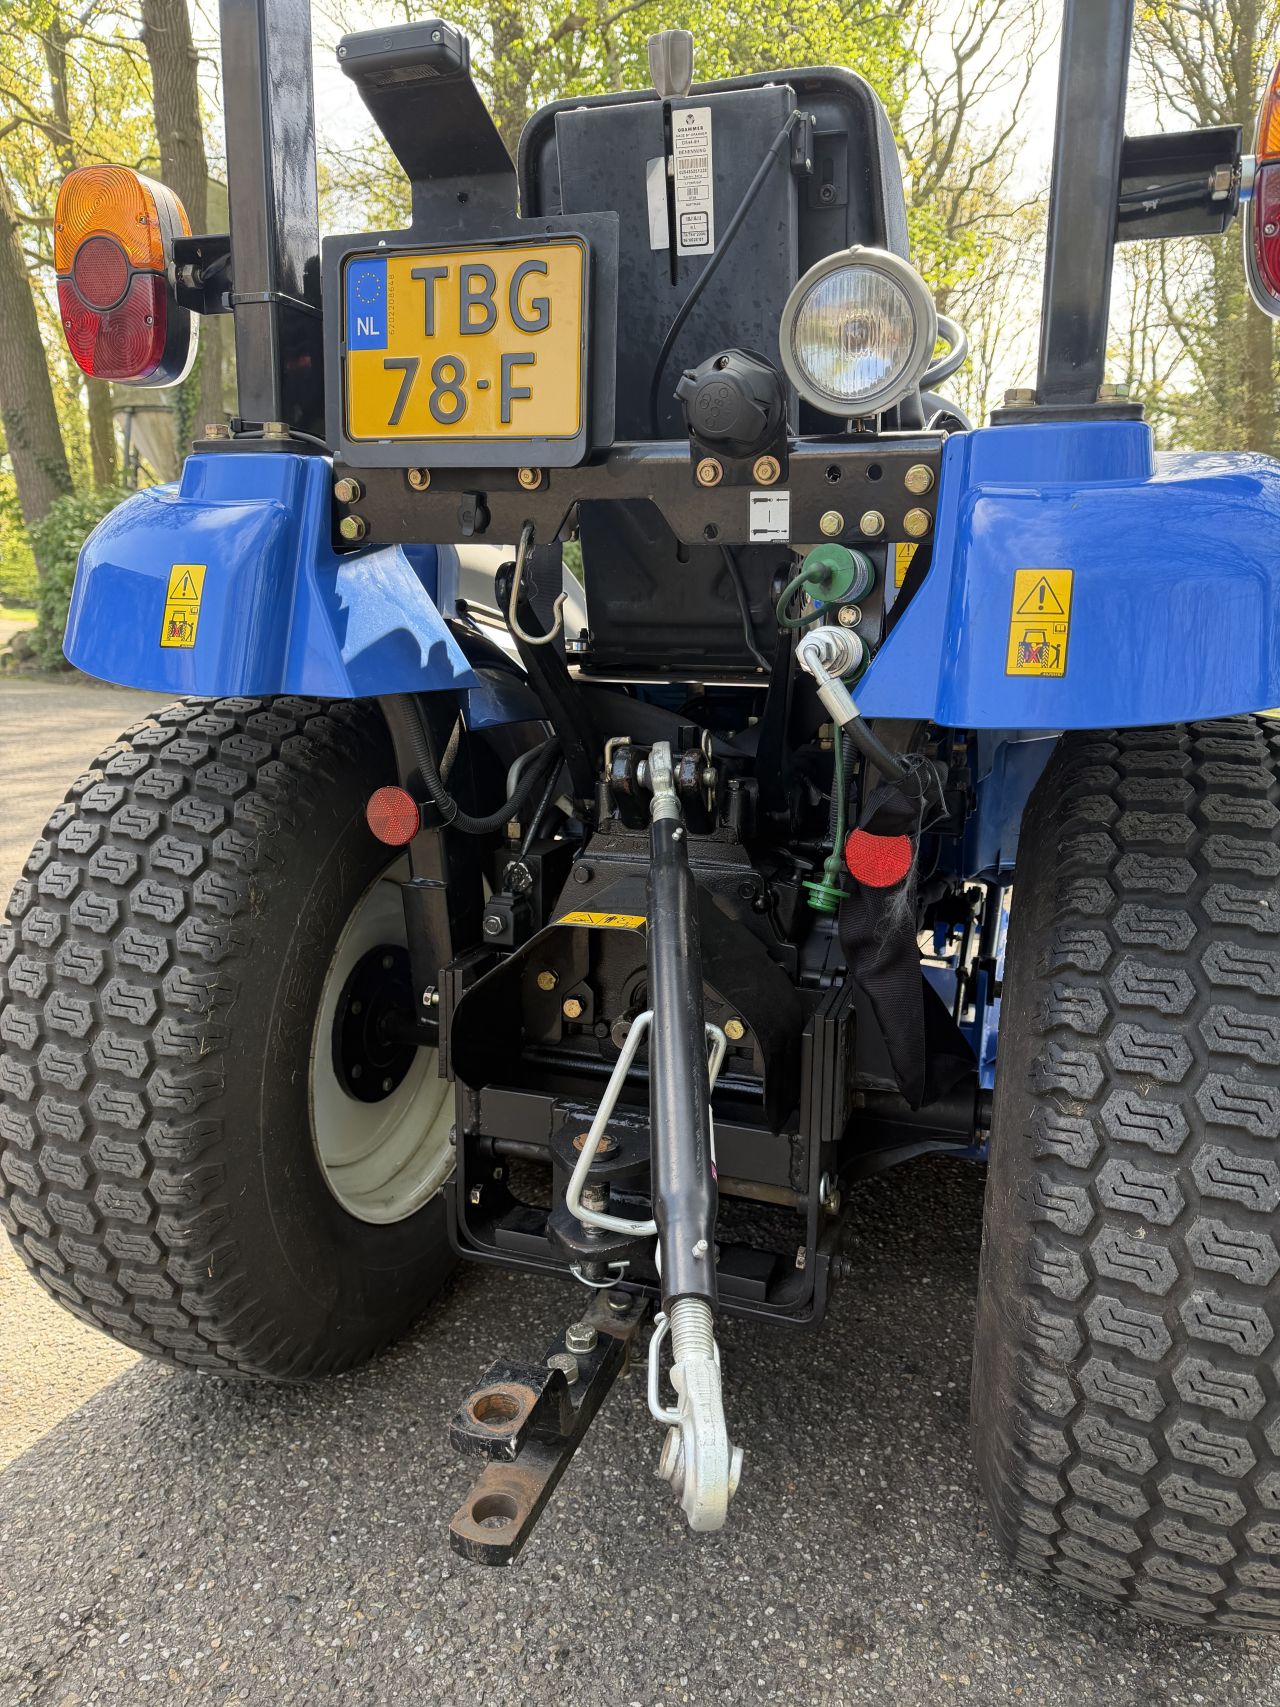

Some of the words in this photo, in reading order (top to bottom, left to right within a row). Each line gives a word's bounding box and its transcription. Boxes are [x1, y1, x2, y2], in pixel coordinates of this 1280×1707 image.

[357, 316, 380, 336] NL
[411, 260, 550, 336] TBG
[384, 352, 535, 426] 78-F
